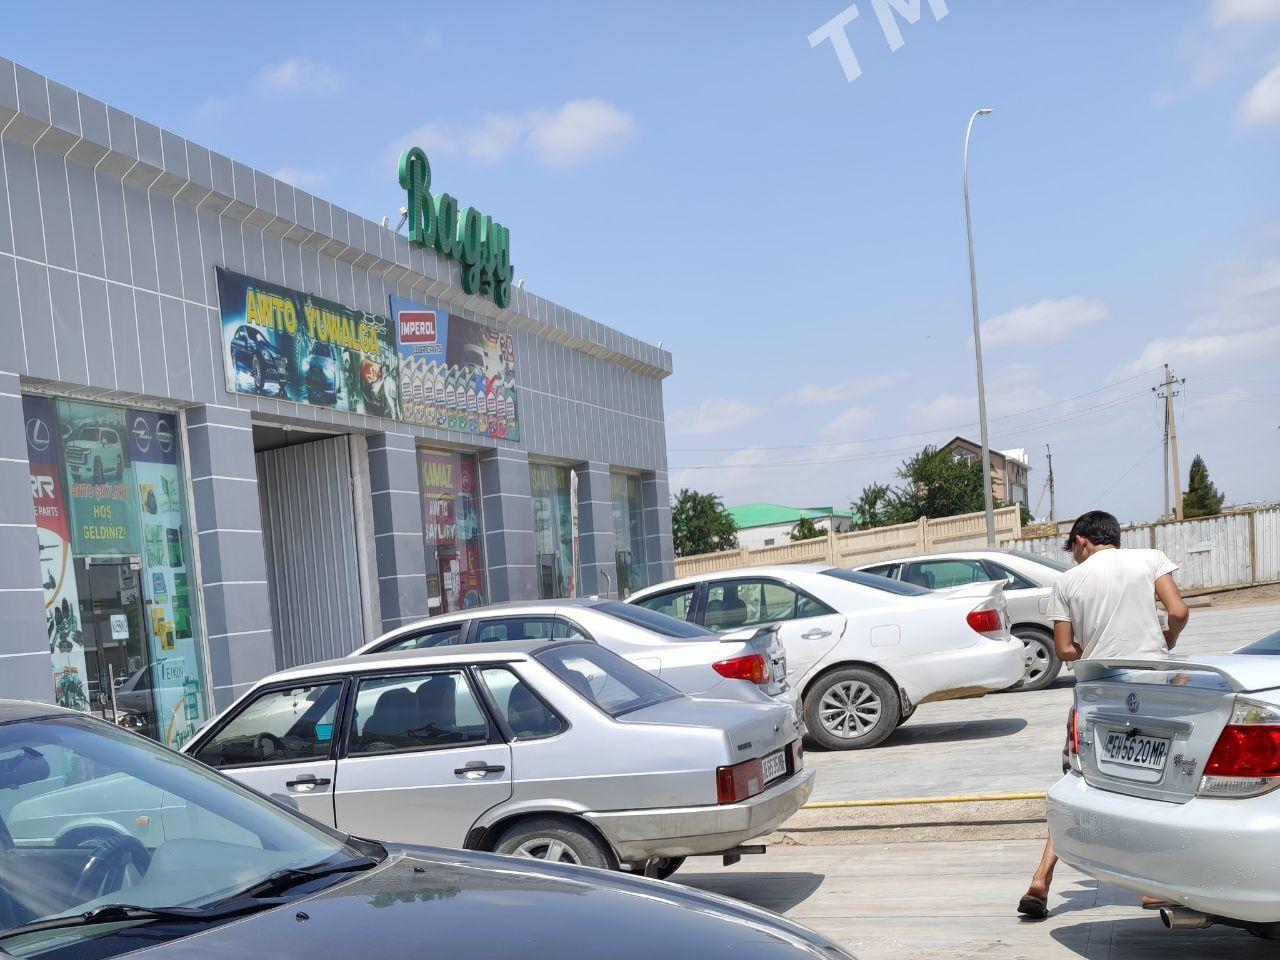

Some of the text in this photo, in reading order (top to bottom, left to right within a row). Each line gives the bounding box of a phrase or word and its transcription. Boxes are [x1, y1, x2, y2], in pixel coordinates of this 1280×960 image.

[245, 286, 297, 335] AWTO
[400, 321, 435, 336] IMPEROL
[423, 461, 454, 489] KAMAZ
[38, 506, 59, 517] PARTS
